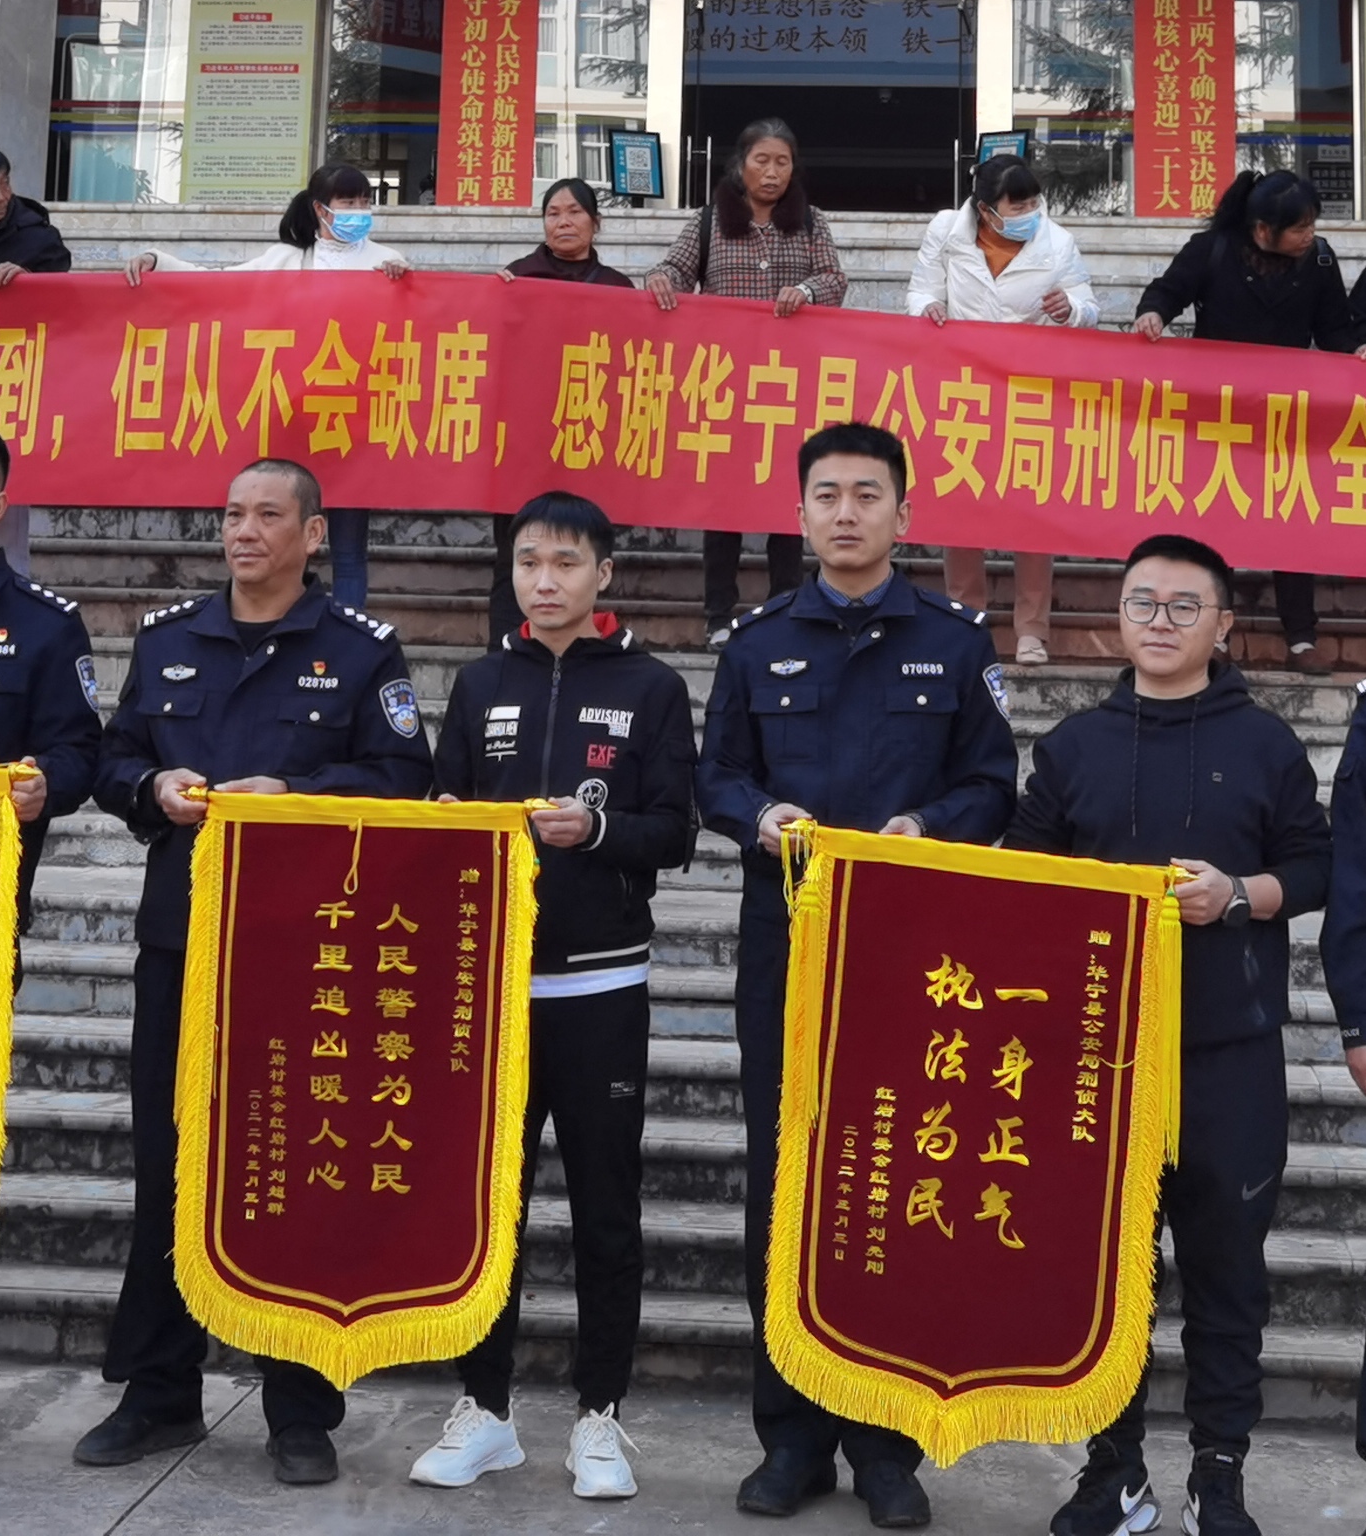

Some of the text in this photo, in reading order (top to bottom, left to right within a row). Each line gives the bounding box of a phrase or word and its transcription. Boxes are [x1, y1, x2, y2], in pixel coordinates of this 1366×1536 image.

[578, 707, 634, 726] ADVISORY
[307, 900, 356, 1192] 千里追凶暖人心
[371, 903, 420, 1194] 人民警察为人民
[904, 954, 984, 1240] 执法为民
[974, 986, 1049, 1251] 一身正气
